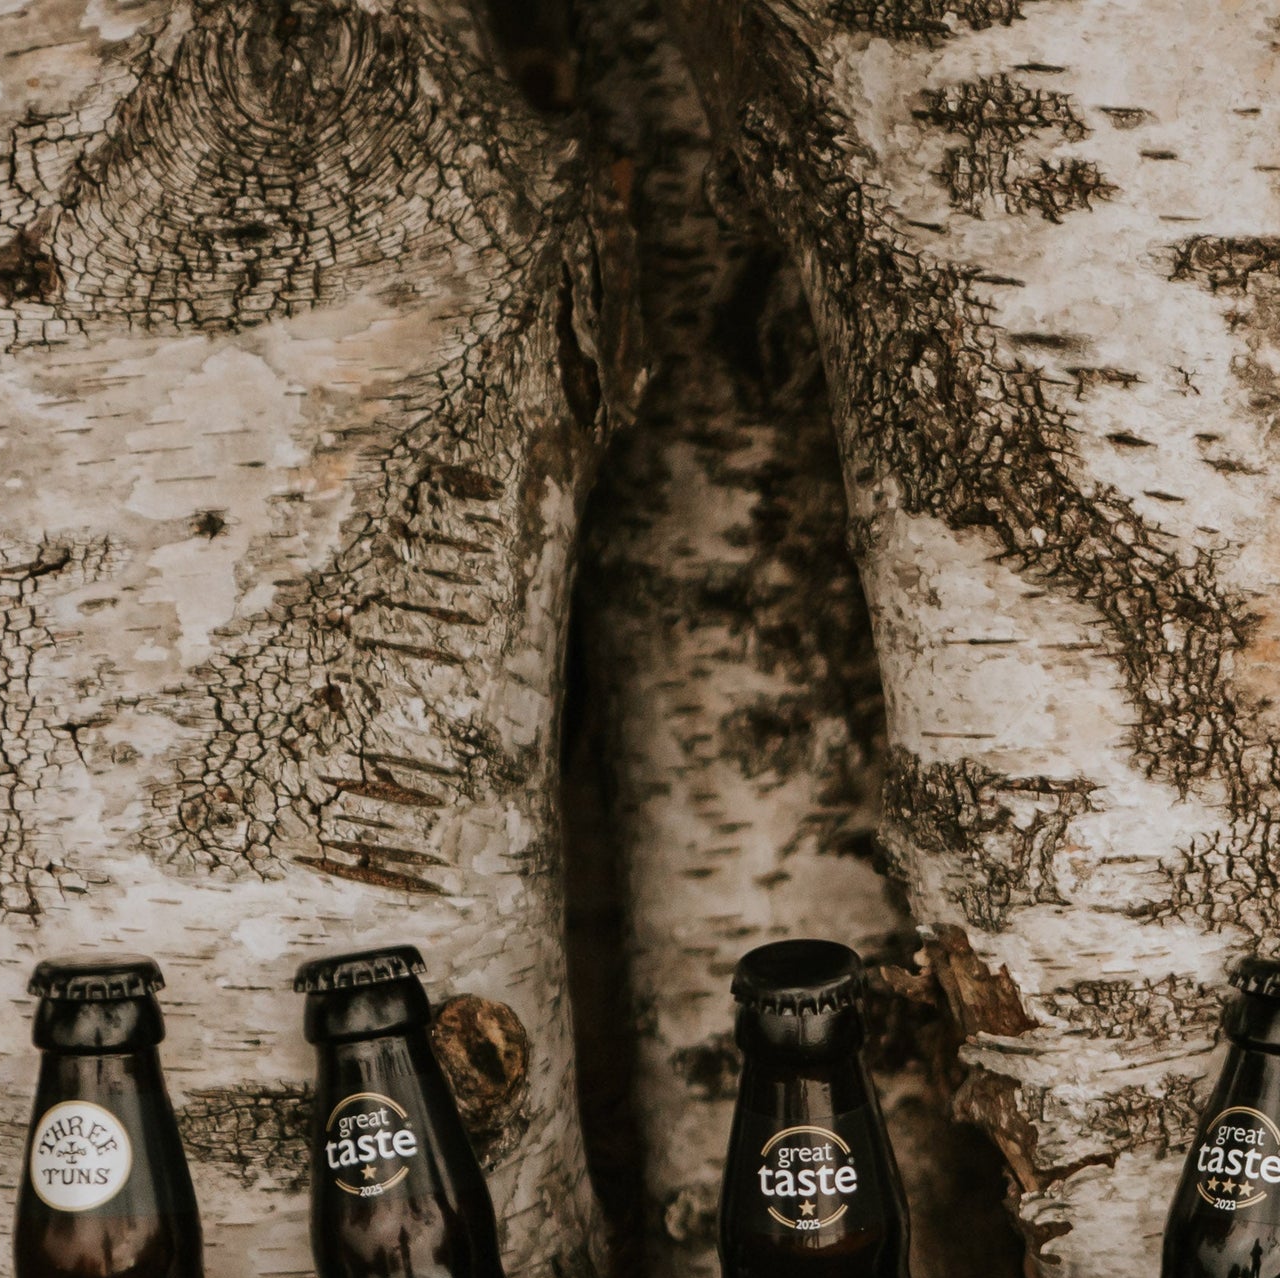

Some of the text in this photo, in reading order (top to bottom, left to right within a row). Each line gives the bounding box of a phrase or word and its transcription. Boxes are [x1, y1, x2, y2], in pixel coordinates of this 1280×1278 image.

[339, 1107, 390, 1138] great
[38, 1116, 117, 1155] THREE
[1216, 1126, 1265, 1146] great
[325, 1129, 418, 1169] taste
[778, 1143, 833, 1168] great
[41, 1168, 110, 1185] TUNS
[758, 1165, 857, 1196] taste
[360, 1183, 384, 1197] 2025
[1214, 1198, 1236, 1210] 2023
[796, 1219, 821, 1230] 2025
